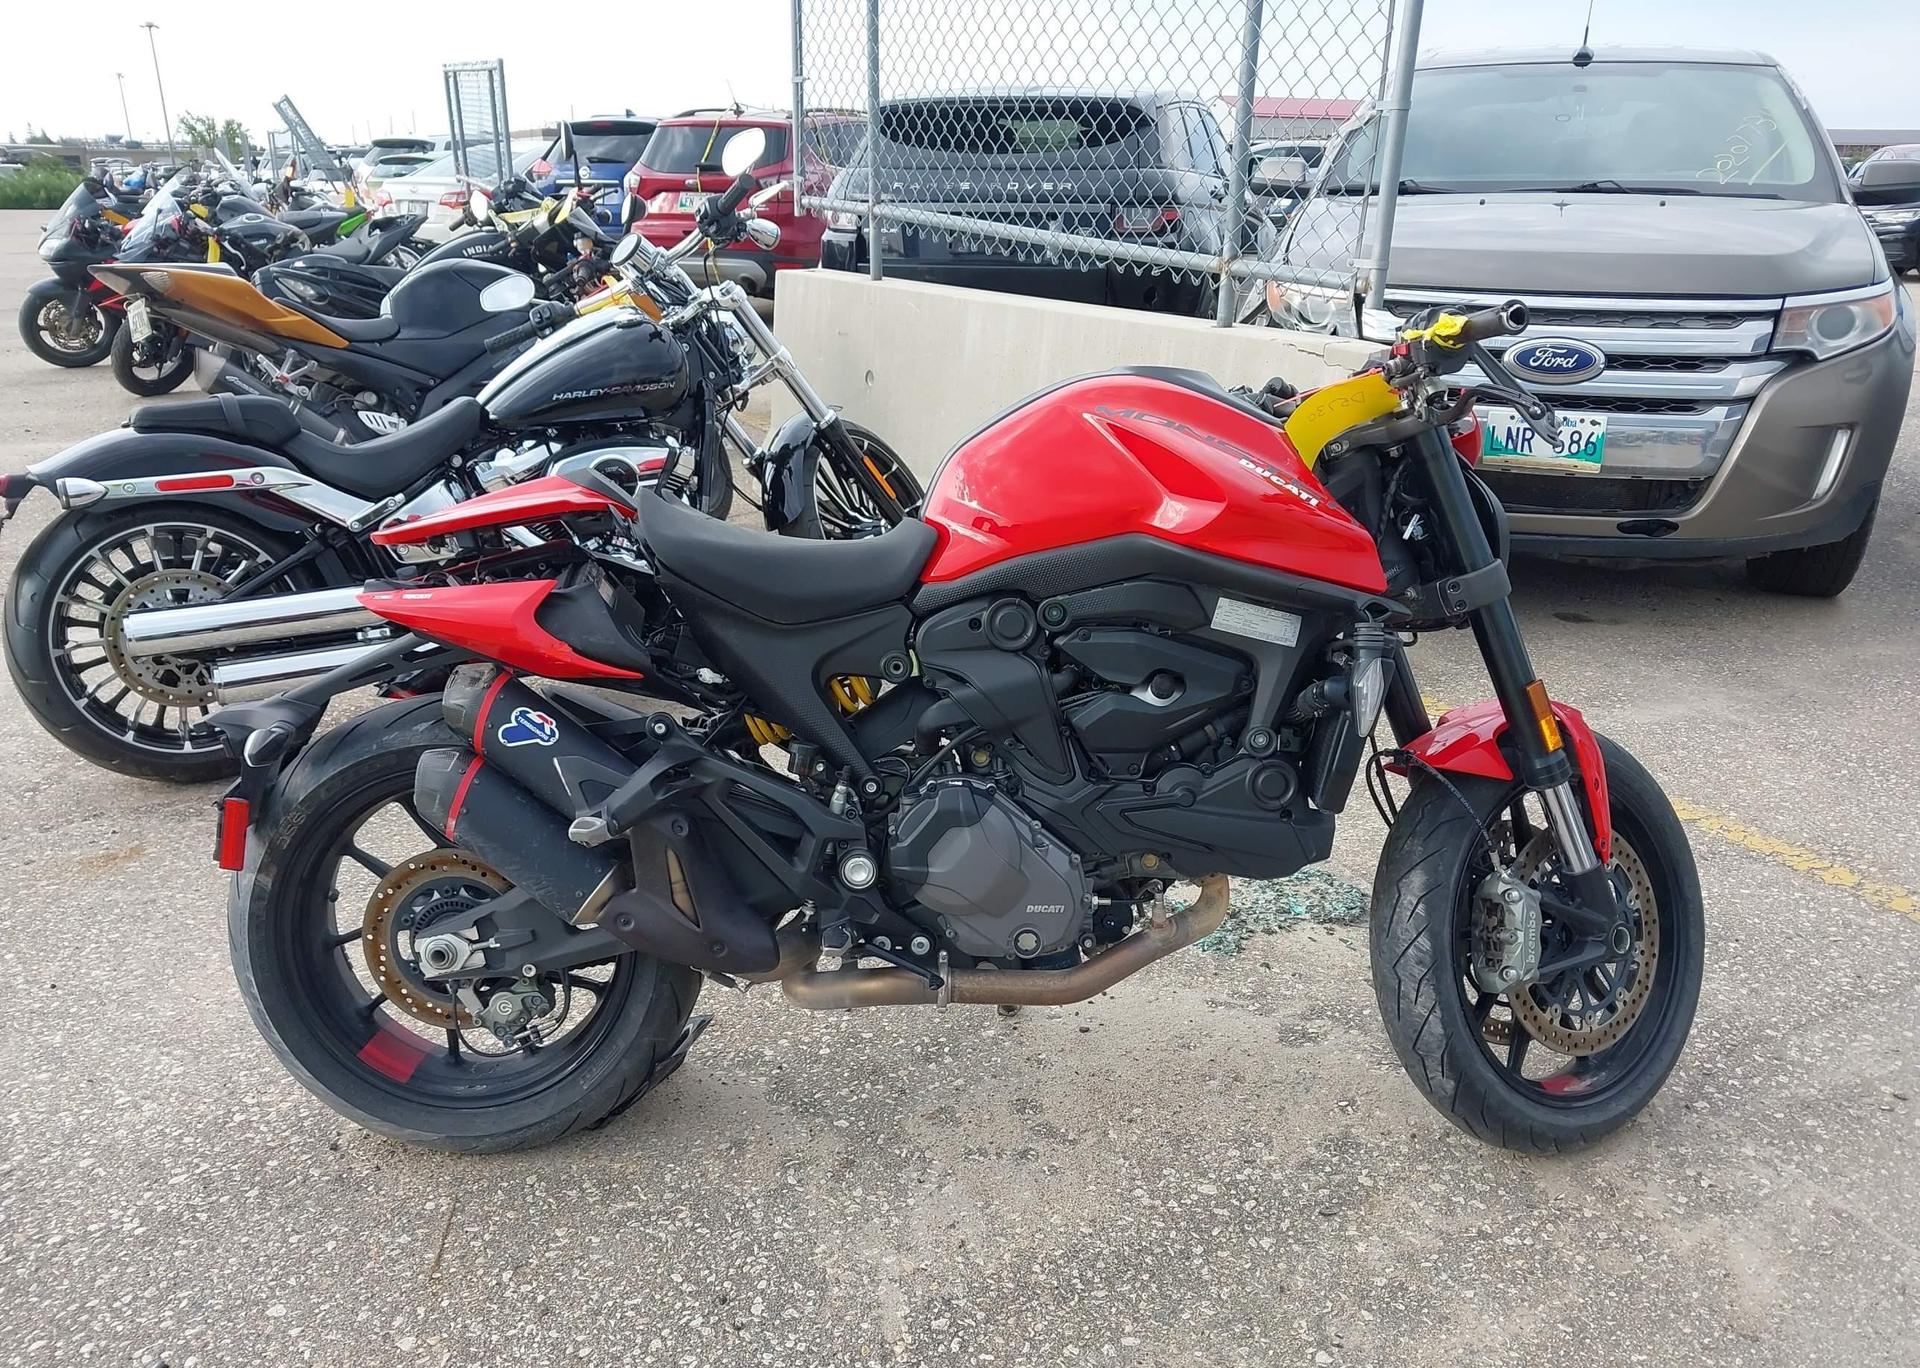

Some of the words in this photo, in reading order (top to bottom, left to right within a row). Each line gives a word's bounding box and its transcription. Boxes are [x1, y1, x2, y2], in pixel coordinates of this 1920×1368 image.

[462, 244, 495, 257] INDIA
[1529, 347, 1579, 369] Ford
[552, 381, 676, 401] HARLEY-DAVIDSON
[1489, 425, 1536, 454] LNR
[1552, 430, 1598, 456] 686
[1238, 458, 1320, 507] DUCATI
[1026, 905, 1065, 913] DUCATI
[1525, 910, 1537, 964] brembo
